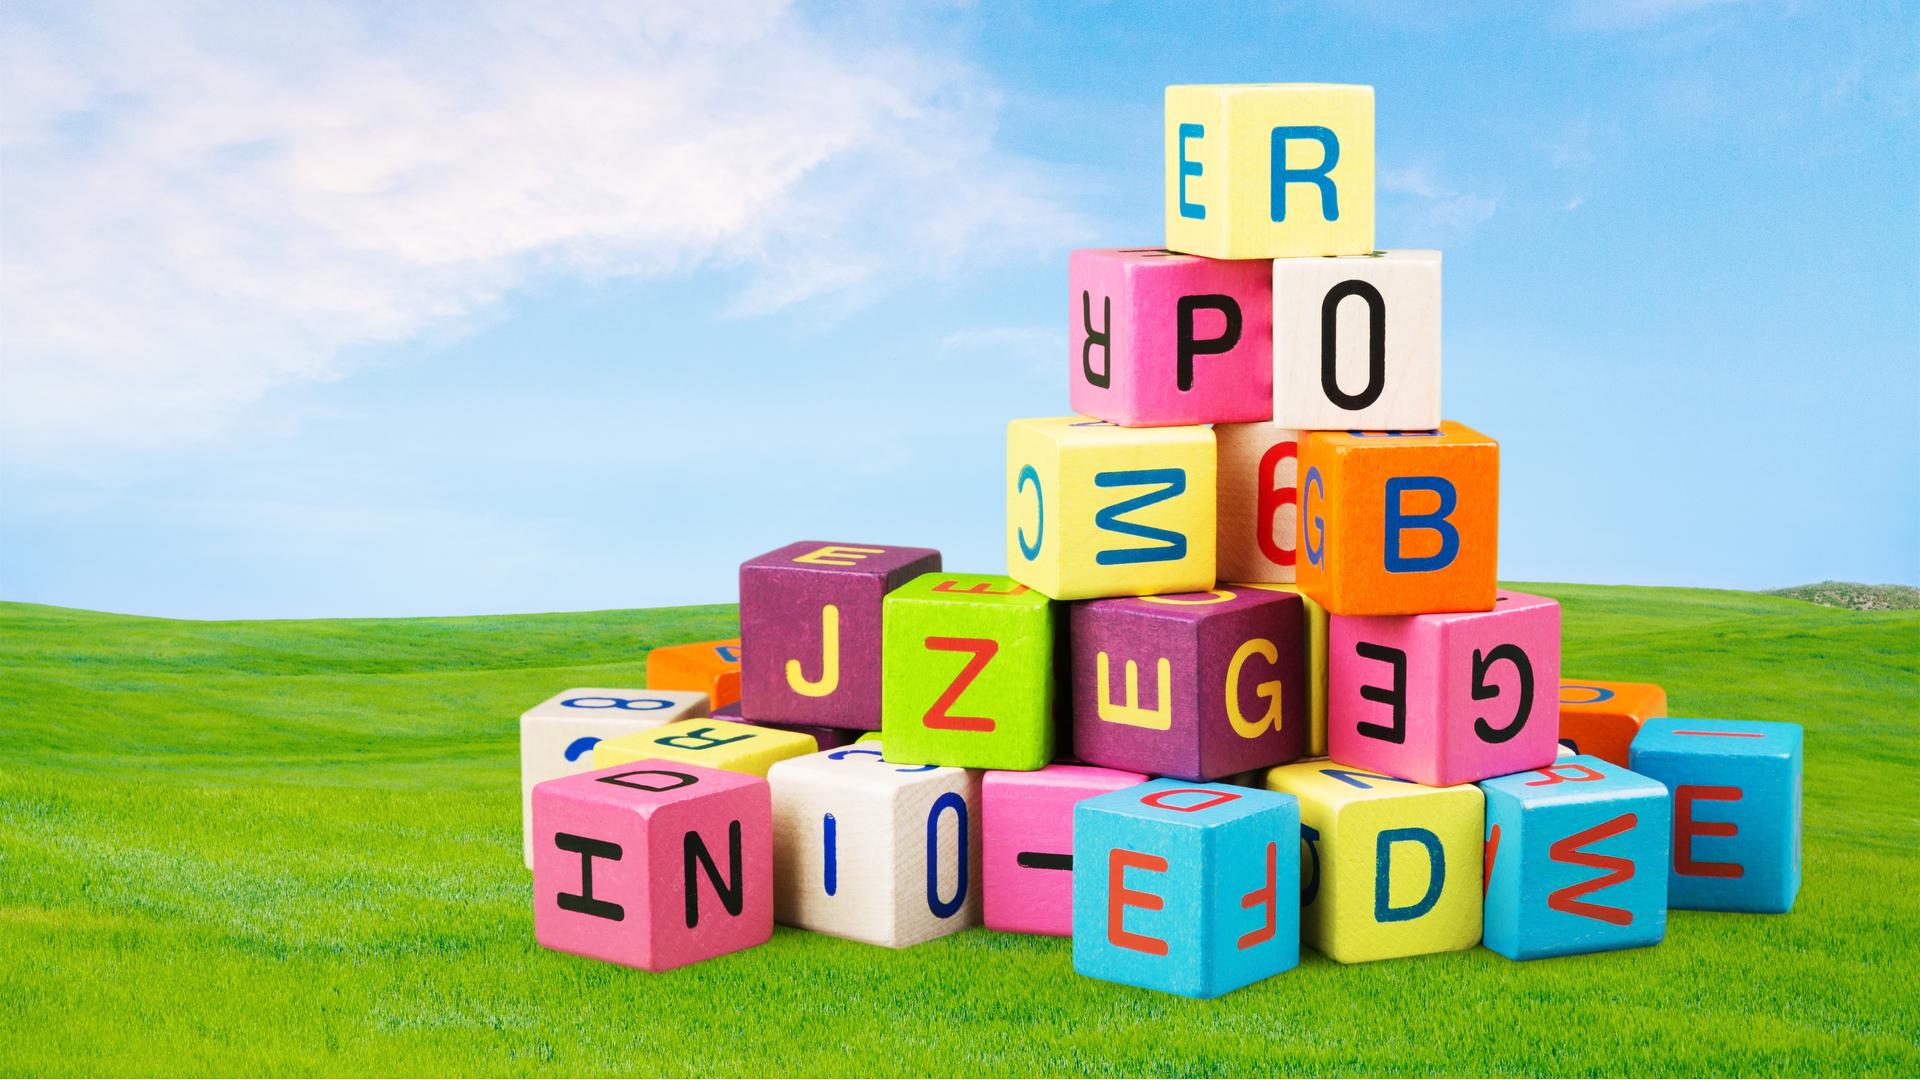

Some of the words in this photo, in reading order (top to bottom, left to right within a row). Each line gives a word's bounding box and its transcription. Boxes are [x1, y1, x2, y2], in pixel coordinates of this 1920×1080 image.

[1179, 123, 1207, 221] E
[1270, 125, 1341, 223] R
[1082, 289, 1112, 389] R
[1176, 293, 1243, 392] P
[793, 546, 886, 566] E
[1017, 464, 1044, 561] C
[1303, 465, 1326, 573] G
[1383, 476, 1461, 574] B
[785, 604, 840, 697] J
[922, 636, 1000, 733] Z
[1096, 651, 1172, 731] E
[1225, 638, 1283, 739] G
[1356, 641, 1408, 745] E
[1472, 643, 1535, 744] G
[560, 696, 676, 711] 8
[653, 727, 758, 751] R
[595, 769, 700, 793] D
[1139, 788, 1244, 813] D
[683, 819, 744, 930] N
[1374, 827, 1446, 924] D
[1673, 784, 1745, 879] E
[1107, 847, 1170, 957] E
[1236, 841, 1278, 951] F
